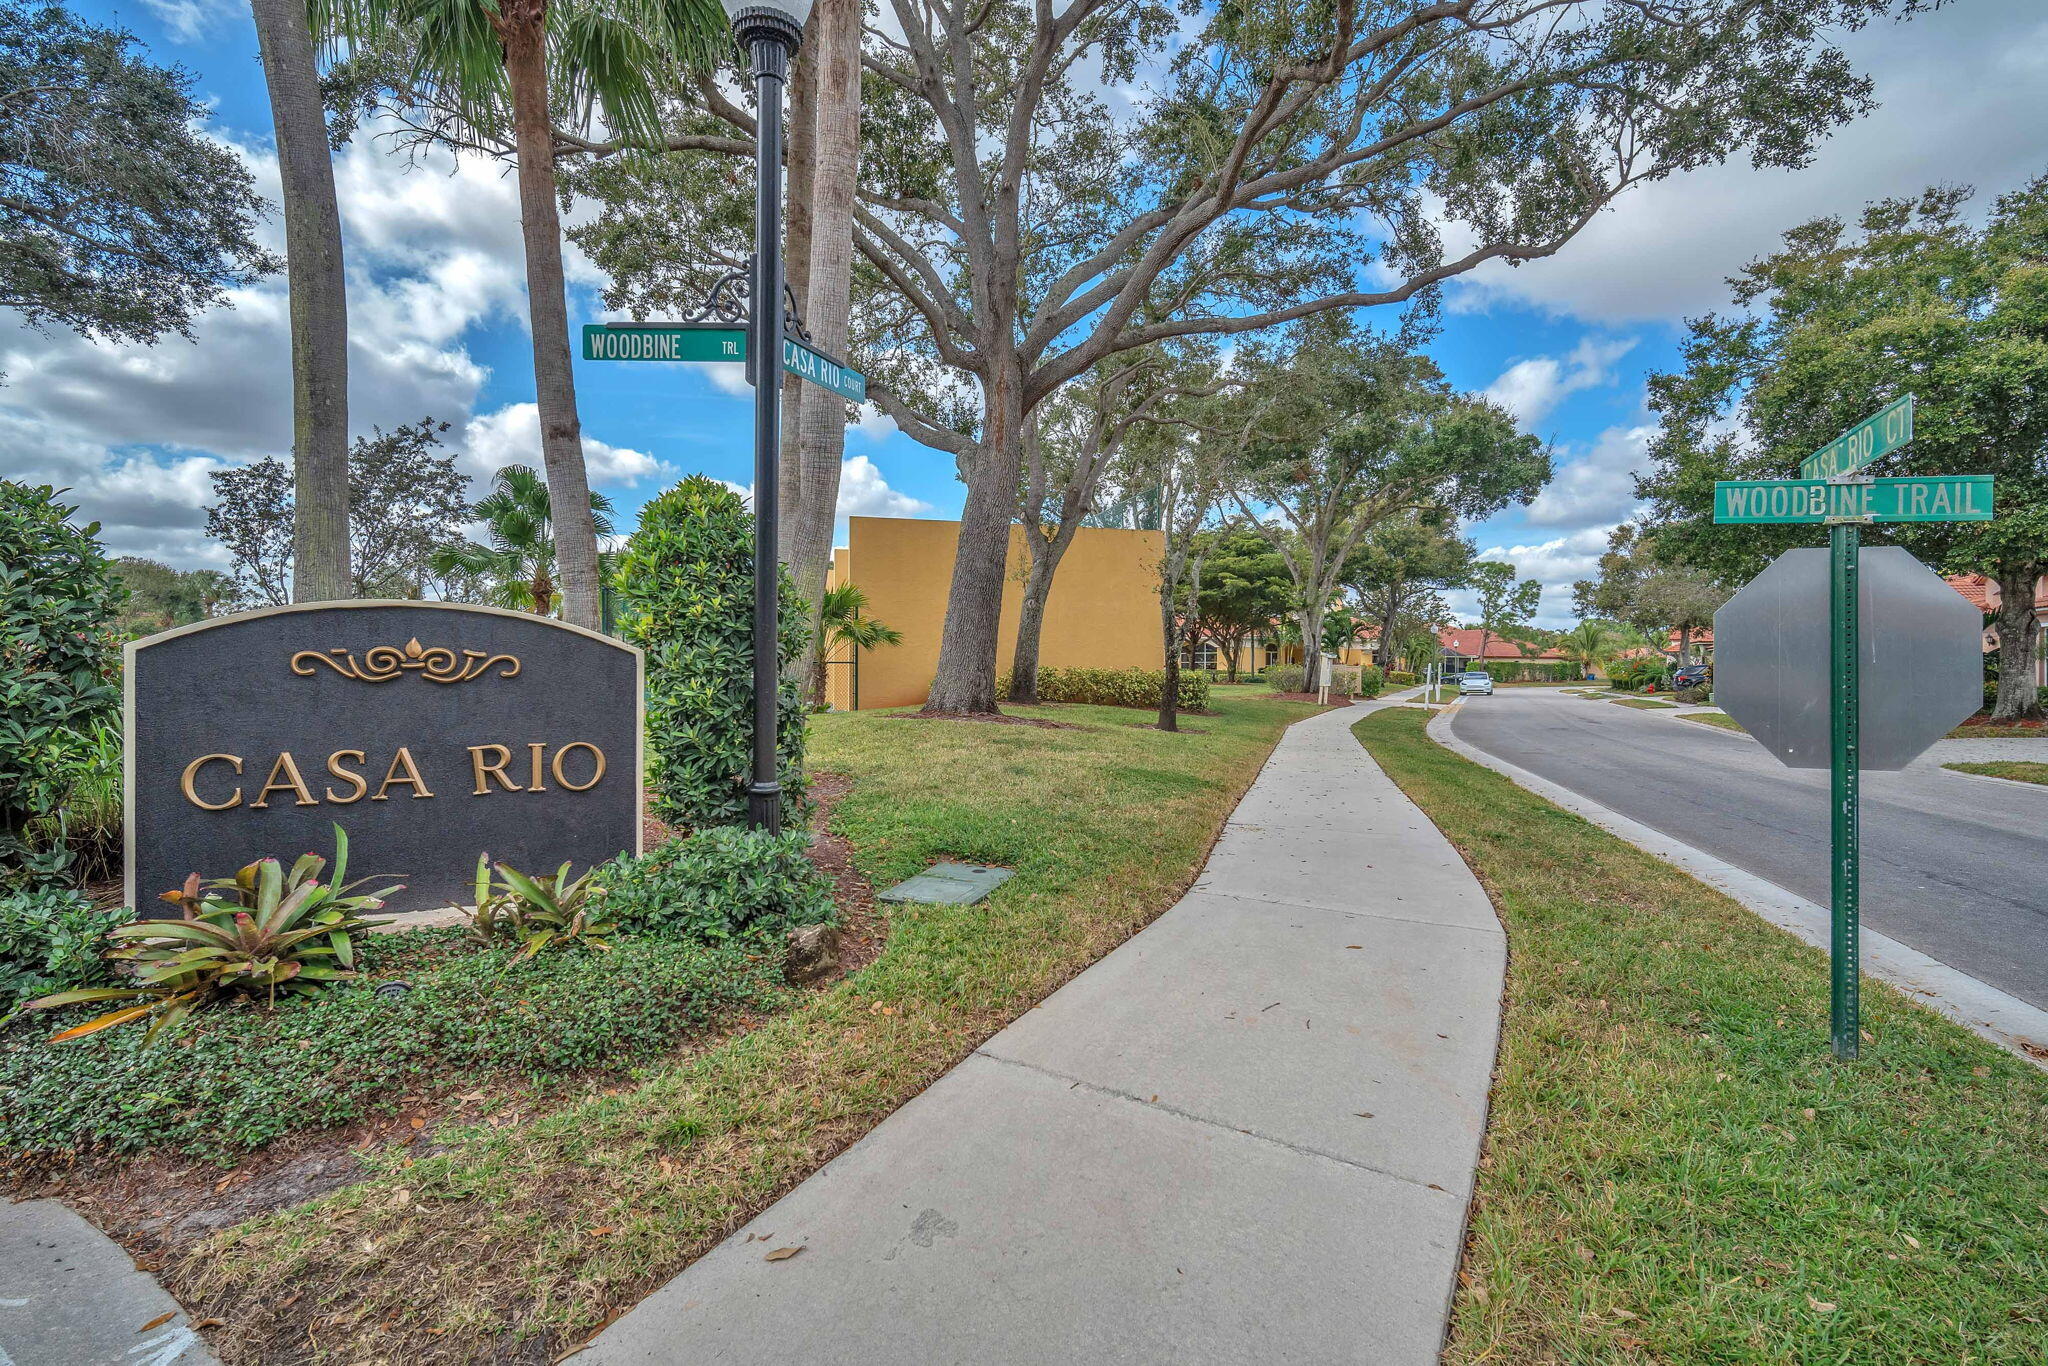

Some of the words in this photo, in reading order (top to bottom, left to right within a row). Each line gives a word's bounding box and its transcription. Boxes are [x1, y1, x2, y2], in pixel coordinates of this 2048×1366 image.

[591, 334, 681, 359] WOODBINE
[722, 341, 739, 355] TRL
[783, 339, 816, 378] CASA
[821, 359, 840, 388] RIO
[844, 375, 861, 393] COURT
[1848, 425, 1873, 467] RIO
[1886, 404, 1906, 444] CT
[1726, 484, 1877, 517] WOODBINE
[1894, 482, 1981, 515] TRAIL
[180, 747, 434, 811] CASA
[467, 741, 607, 796] RIO
